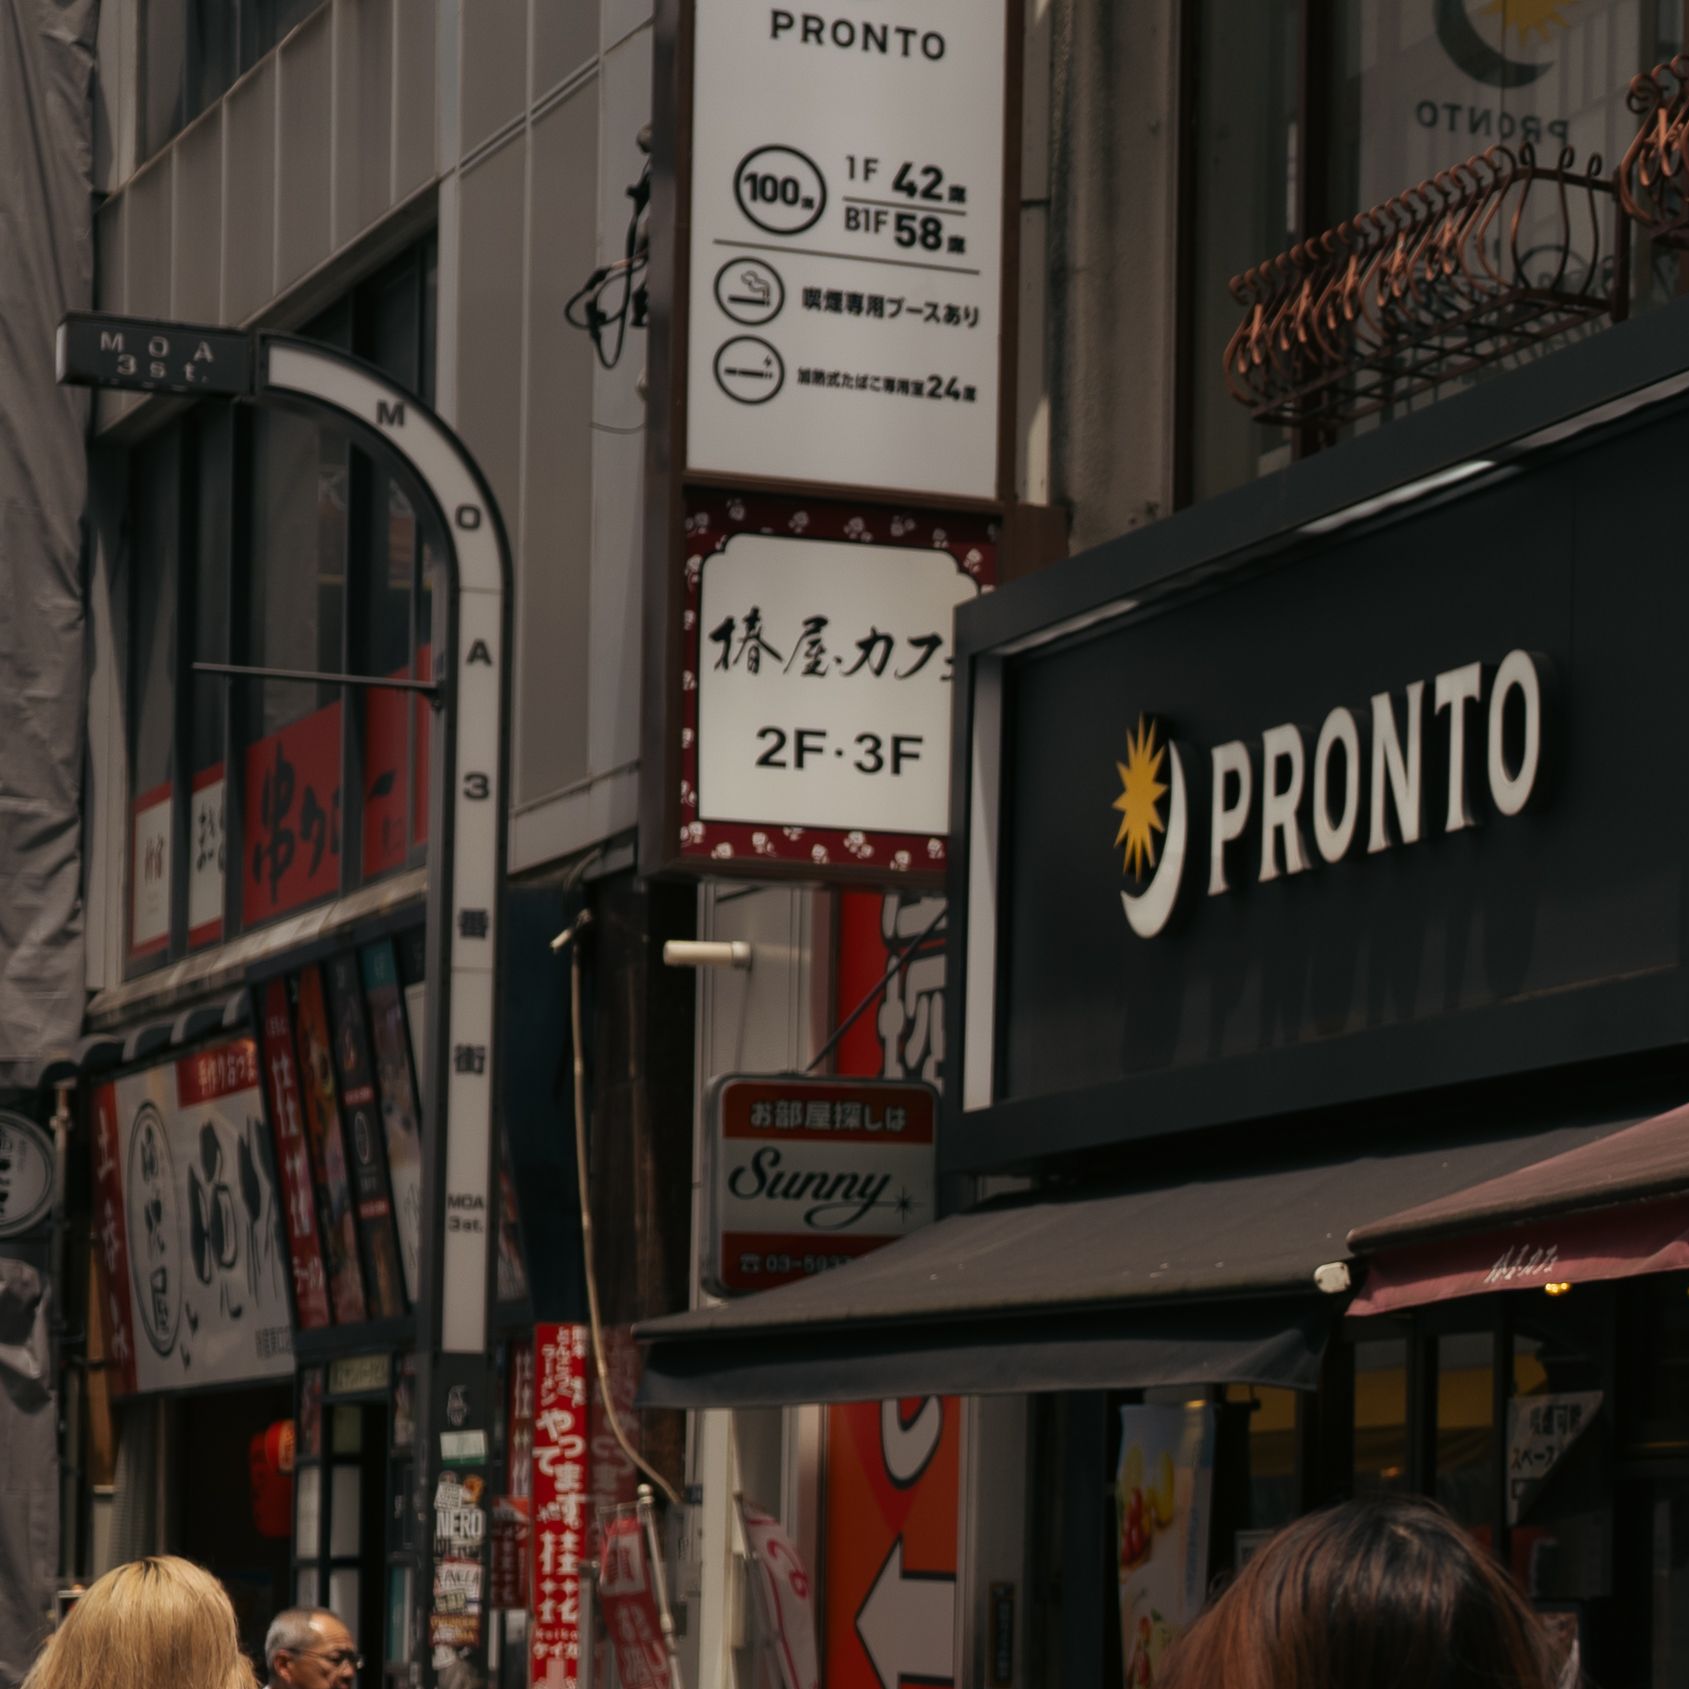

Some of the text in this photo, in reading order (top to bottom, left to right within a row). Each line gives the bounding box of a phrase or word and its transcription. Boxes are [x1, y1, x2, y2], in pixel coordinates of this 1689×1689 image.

[770, 9, 946, 60] PRONTO
[845, 155, 879, 182] 1F
[844, 207, 889, 234] B1F
[802, 286, 980, 329] 喫煙専用ブースあり
[1208, 649, 1540, 897] PRONTO
[750, 1100, 907, 1133] お部屋探しは
[728, 1146, 896, 1231] Sunny
